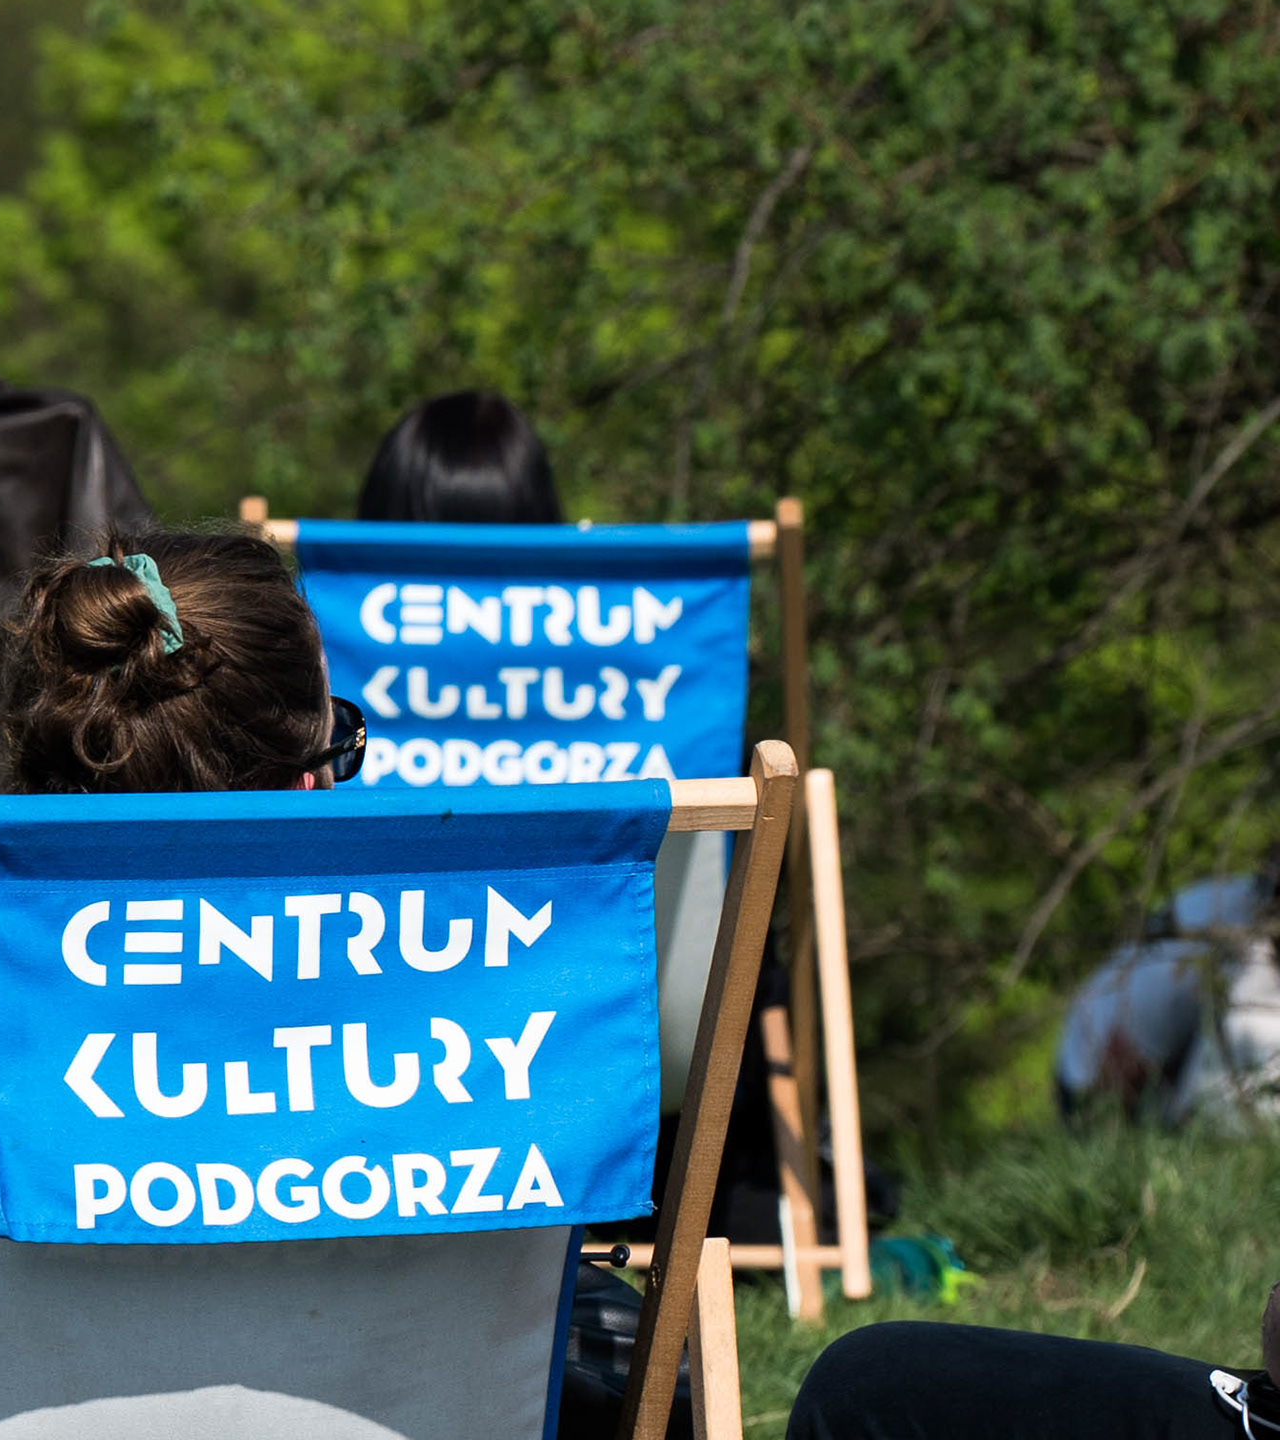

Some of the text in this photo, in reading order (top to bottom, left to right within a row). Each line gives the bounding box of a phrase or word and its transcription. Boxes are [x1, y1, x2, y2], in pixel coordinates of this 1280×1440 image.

[360, 583, 683, 646] CENTRUM
[362, 665, 682, 721] KULTURY
[61, 885, 553, 987] CENTRUM
[63, 1010, 557, 1118] KULTURY
